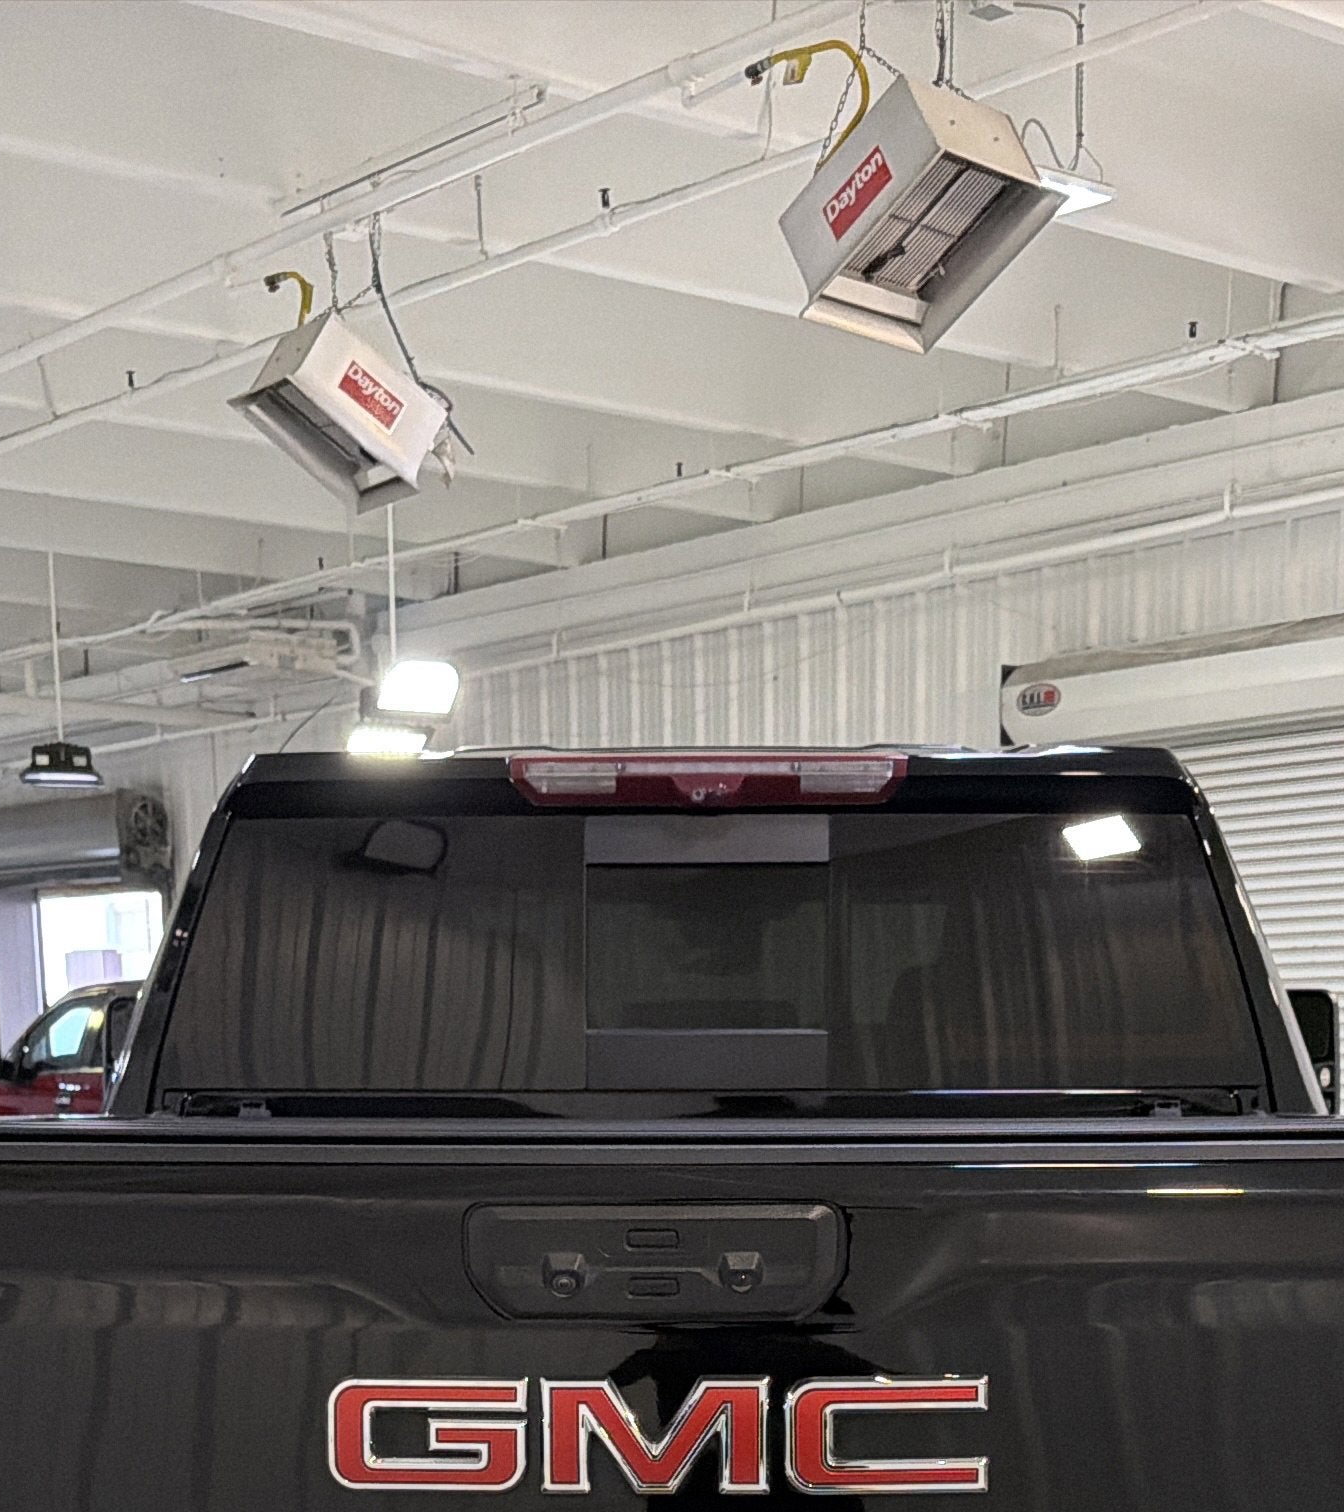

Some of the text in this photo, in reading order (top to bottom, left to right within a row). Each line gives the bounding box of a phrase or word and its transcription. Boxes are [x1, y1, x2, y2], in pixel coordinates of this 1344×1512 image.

[824, 151, 883, 224] Dayton
[347, 365, 401, 415] Dayton
[328, 1376, 989, 1495] GMC
